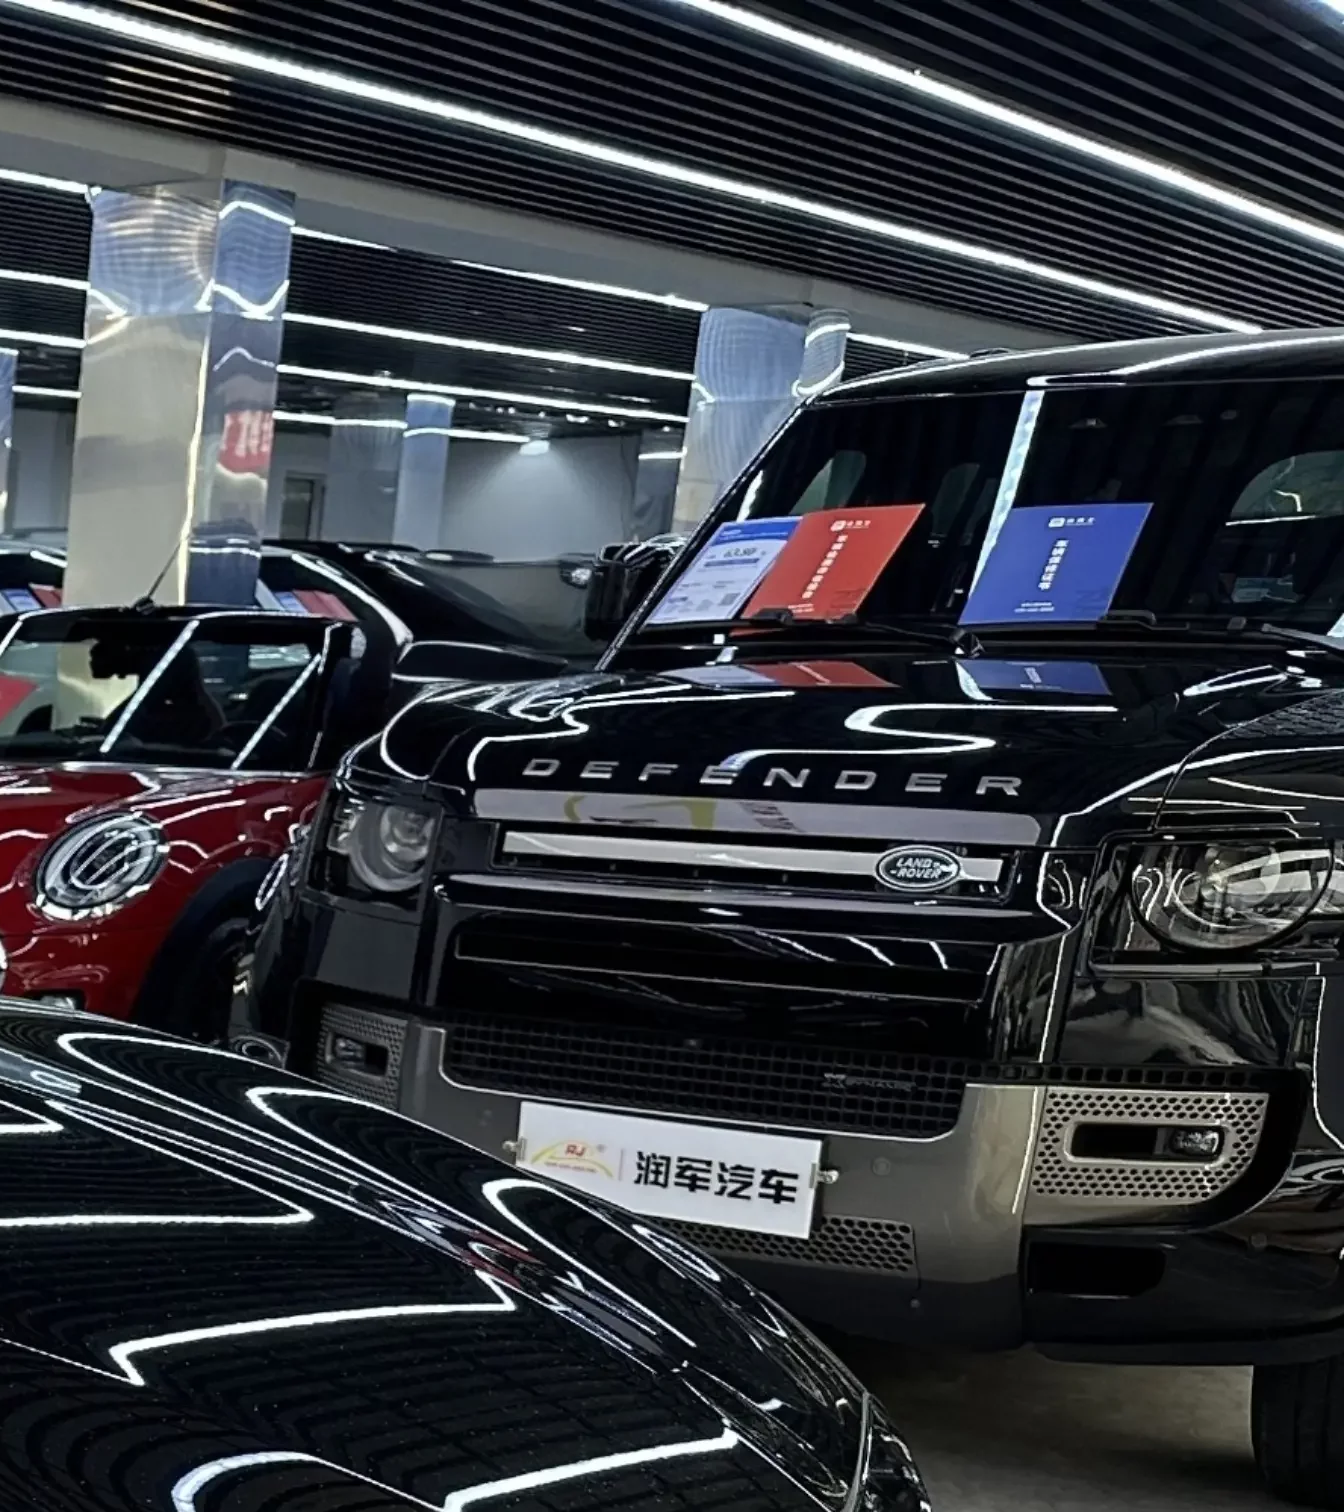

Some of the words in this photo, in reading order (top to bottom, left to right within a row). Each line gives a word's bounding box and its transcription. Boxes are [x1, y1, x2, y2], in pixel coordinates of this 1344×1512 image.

[521, 757, 1023, 797] DEFENDER
[895, 856, 933, 868] LAND
[896, 868, 942, 879] ROVER
[633, 1150, 800, 1205] 润军汽车
